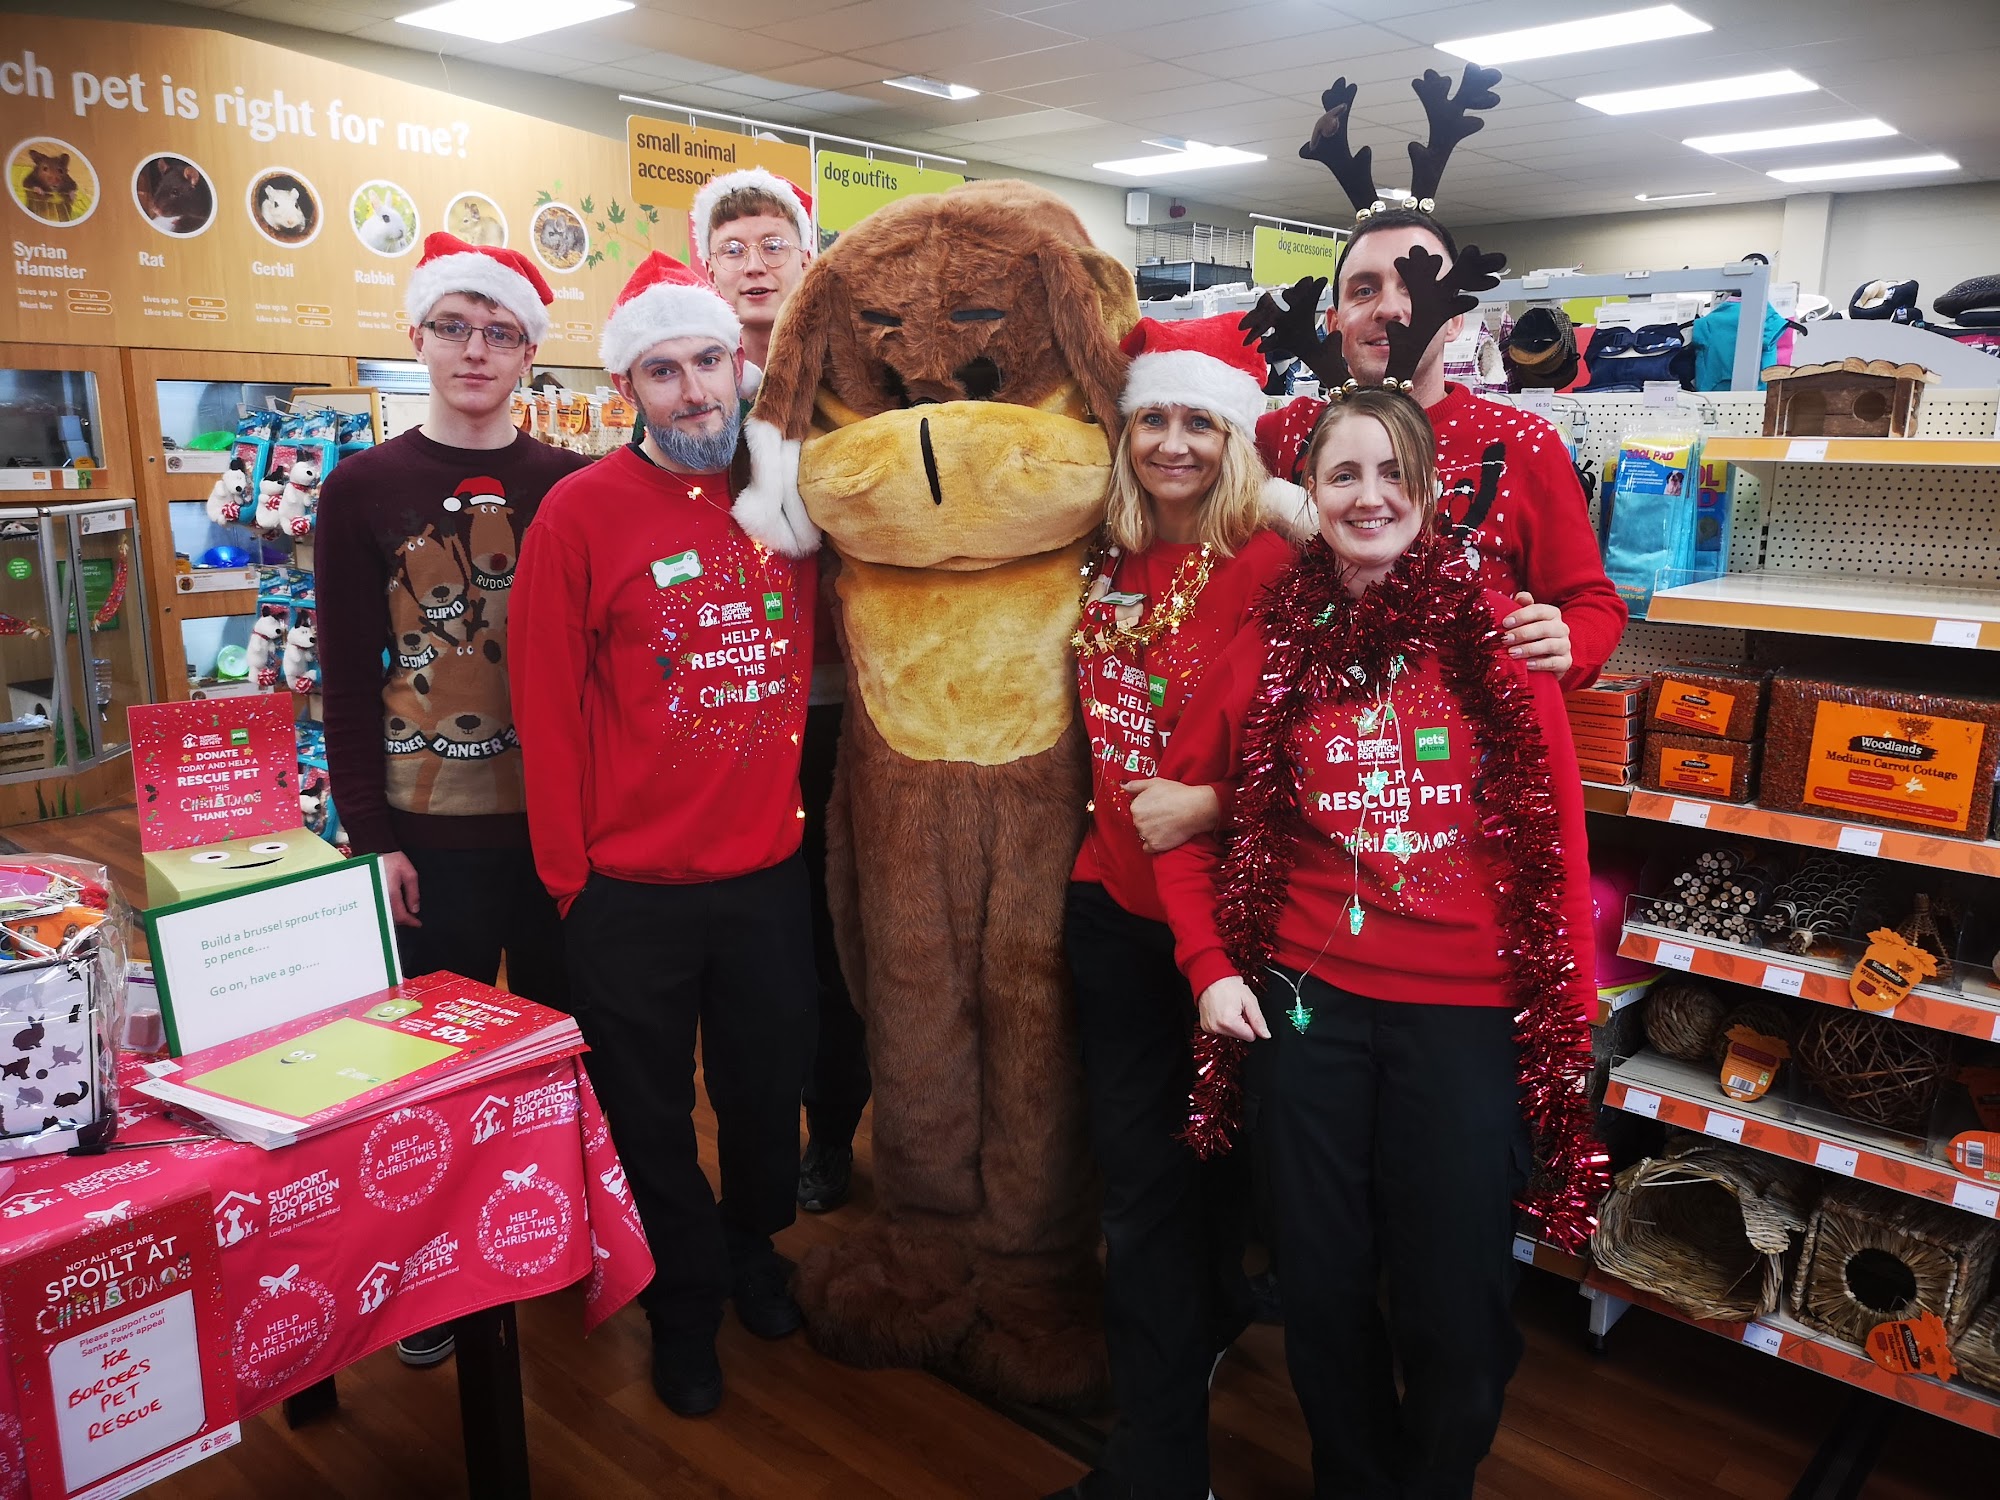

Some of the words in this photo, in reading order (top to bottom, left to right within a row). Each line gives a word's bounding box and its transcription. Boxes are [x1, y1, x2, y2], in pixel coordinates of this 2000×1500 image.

[71, 71, 149, 117] pet
[161, 74, 200, 120] is
[215, 86, 316, 142] right
[326, 99, 384, 146] for
[396, 121, 470, 159] me?
[637, 131, 680, 155] small
[684, 137, 736, 164] animal
[824, 161, 849, 187] dog
[852, 164, 898, 191] outfits
[13, 240, 68, 261] Syrian
[1278, 236, 1291, 254] dog
[1293, 243, 1333, 258] accessories
[15, 260, 87, 280] Hamster
[138, 251, 165, 268] Rat
[252, 261, 295, 278] Gerbil
[354, 270, 396, 286] Rabbit
[17, 287, 37, 296] Lives
[38, 289, 49, 298] up
[143, 295, 161, 304] Lives
[1626, 449, 1651, 461] COOL
[1653, 450, 1674, 461] PAD
[426, 600, 465, 619] CUPID
[765, 599, 781, 609] pets
[733, 612, 750, 620] PETS
[722, 629, 760, 645] HELP
[765, 627, 773, 640] A
[400, 646, 435, 668] COMET
[691, 644, 766, 670] RESCUE
[734, 664, 765, 677] THIS
[1121, 676, 1134, 685] FOR
[1150, 681, 1163, 693] pets
[1090, 701, 1156, 734] RESCUE
[232, 732, 247, 740] pets
[384, 734, 427, 753] ASHER
[1123, 730, 1150, 747] THIS
[1357, 739, 1393, 747] SUPPORT
[1419, 734, 1445, 747] pets
[1862, 736, 1923, 755] Woodlands
[196, 749, 239, 761] DONATE
[433, 737, 504, 758] DANCER
[1358, 745, 1399, 753] ADOPTION
[1358, 752, 1374, 760] FOR
[1376, 751, 1396, 759] PETS
[177, 763, 206, 773] TODAY
[208, 761, 226, 770] AND
[228, 758, 250, 768] HELP
[1412, 768, 1425, 783] A
[1825, 751, 1870, 766] Medium
[1874, 758, 1910, 773] Carrot
[1913, 765, 1958, 781] Cottage
[177, 771, 230, 787] RESCUE
[234, 768, 260, 780] PET
[208, 784, 229, 793] THIS
[1318, 788, 1411, 811] RESCUE
[1420, 784, 1462, 805] PET
[191, 810, 229, 822] THANK
[232, 807, 253, 816] YOU
[1371, 809, 1409, 824] THIS
[201, 934, 231, 950] Build
[234, 933, 241, 942] a
[244, 920, 283, 939] brussel
[285, 911, 320, 930] sprout
[321, 907, 337, 918] for
[338, 901, 358, 916] just
[204, 956, 218, 968] 50
[1673, 954, 1691, 962] £2.50
[1860, 967, 1881, 984] Willow
[1872, 961, 1902, 982] Woodlands
[210, 986, 226, 997] Go
[229, 979, 247, 990] on,
[250, 970, 277, 985] have
[279, 968, 286, 976] a
[1781, 978, 1799, 987] £2.50
[479, 1003, 501, 1011] YOUR
[500, 1008, 521, 1017] OWN
[430, 1025, 472, 1043] 50p
[512, 1088, 574, 1117] ADOPTION
[513, 1081, 564, 1106] SUPPORT
[512, 1114, 535, 1128] FOR
[537, 1103, 568, 1121] PETS
[512, 1126, 531, 1138] Loving
[532, 1121, 550, 1132] homes
[391, 1134, 420, 1152] HELP
[376, 1159, 385, 1170] A
[387, 1149, 408, 1165] PET
[411, 1139, 435, 1156] THIS
[376, 1149, 437, 1180] CHRISTMAS
[61, 1160, 133, 1190] SUPPORT
[67, 1160, 151, 1194] ADOPTION
[71, 1180, 108, 1197] FOR
[109, 1167, 149, 1182] PETS
[267, 1169, 330, 1204] SUPPORT
[268, 1177, 340, 1216] ADOPTION
[268, 1208, 297, 1227] FOR
[300, 1193, 334, 1218] PETS
[1985, 1199, 1994, 1207] £2
[268, 1224, 292, 1238] Loving
[293, 1215, 315, 1229] homes
[316, 1205, 341, 1221] wanted
[509, 1208, 539, 1224] HELP
[494, 1228, 503, 1239] A
[505, 1221, 527, 1236] PET
[530, 1215, 556, 1231] THIS
[494, 1225, 558, 1250] CHRISTMAS
[66, 1258, 88, 1273] NOT
[90, 1252, 109, 1264] ALL
[110, 1241, 134, 1257] PETS
[135, 1234, 155, 1248] ARE
[403, 1239, 459, 1277] ADOPTION
[404, 1232, 450, 1267] SUPPORT
[46, 1252, 137, 1302] SPOILT
[147, 1236, 177, 1264] AT
[399, 1268, 419, 1287] FOR
[421, 1253, 453, 1274] PETS
[415, 1274, 436, 1288] homes
[437, 1265, 460, 1280] wanted
[36, 1252, 192, 1335] CHRISTMAS
[79, 1331, 109, 1348] Please
[111, 1316, 147, 1334] support
[149, 1308, 165, 1320] our
[250, 1341, 259, 1353] A
[262, 1327, 286, 1348] PET
[290, 1317, 318, 1336] THIS
[266, 1314, 300, 1335] HELP
[82, 1342, 108, 1357] Santa
[110, 1332, 134, 1346] Paws
[136, 1317, 166, 1335] appeal
[249, 1328, 319, 1365] CHRISTMAS
[1766, 1338, 1778, 1347] £10
[68, 1359, 151, 1409] BORDERS
[100, 1382, 140, 1413] PET
[88, 1398, 162, 1442] RESCUE
